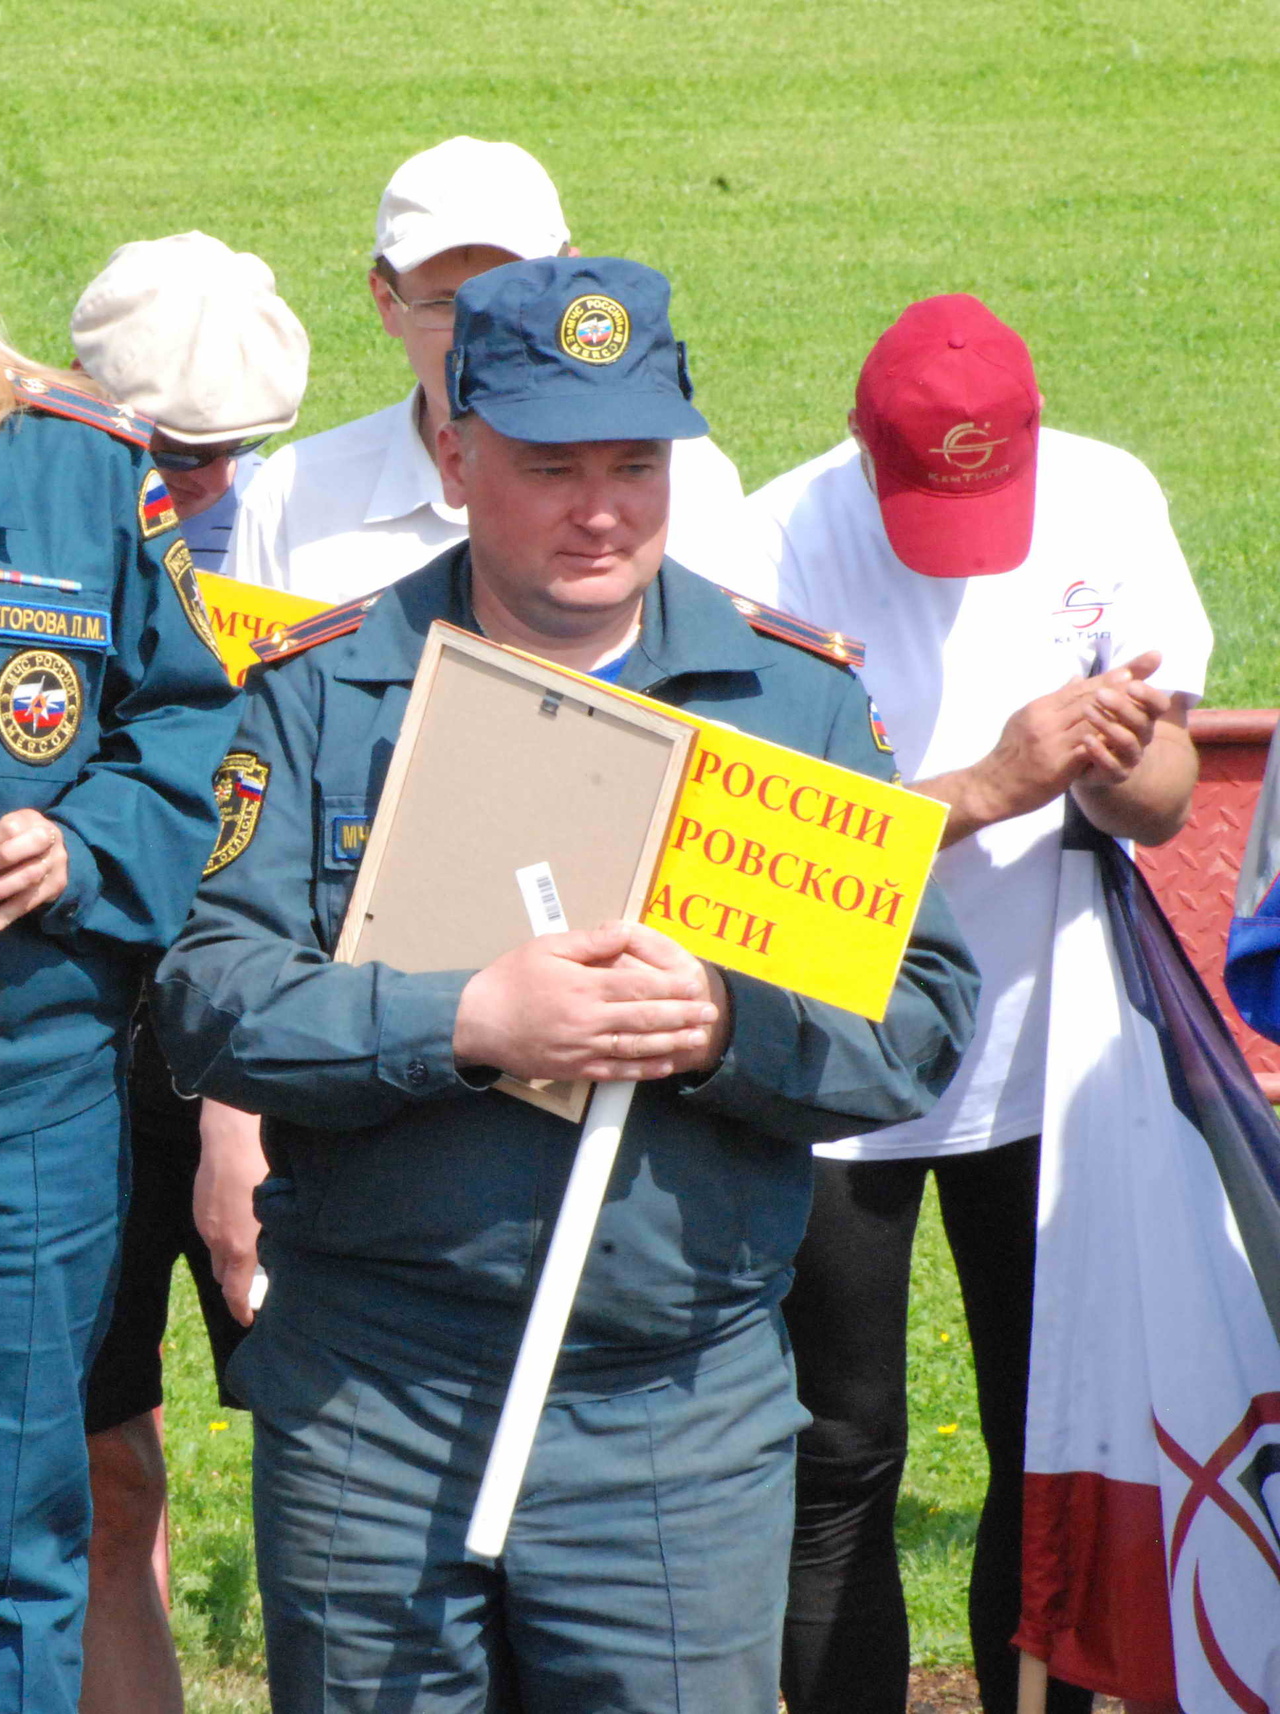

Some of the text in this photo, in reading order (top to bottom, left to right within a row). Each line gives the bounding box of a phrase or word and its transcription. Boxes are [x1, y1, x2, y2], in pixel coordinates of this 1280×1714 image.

[567, 300, 624, 329] МЧС РОССИИ
[566, 332, 624, 359] EMERCOM
[71, 615, 105, 641] Л.М.
[6, 656, 76, 697] МЧС РОССИИ
[1, 711, 73, 753] EMERCOM
[690, 748, 895, 849] РОССИИ
